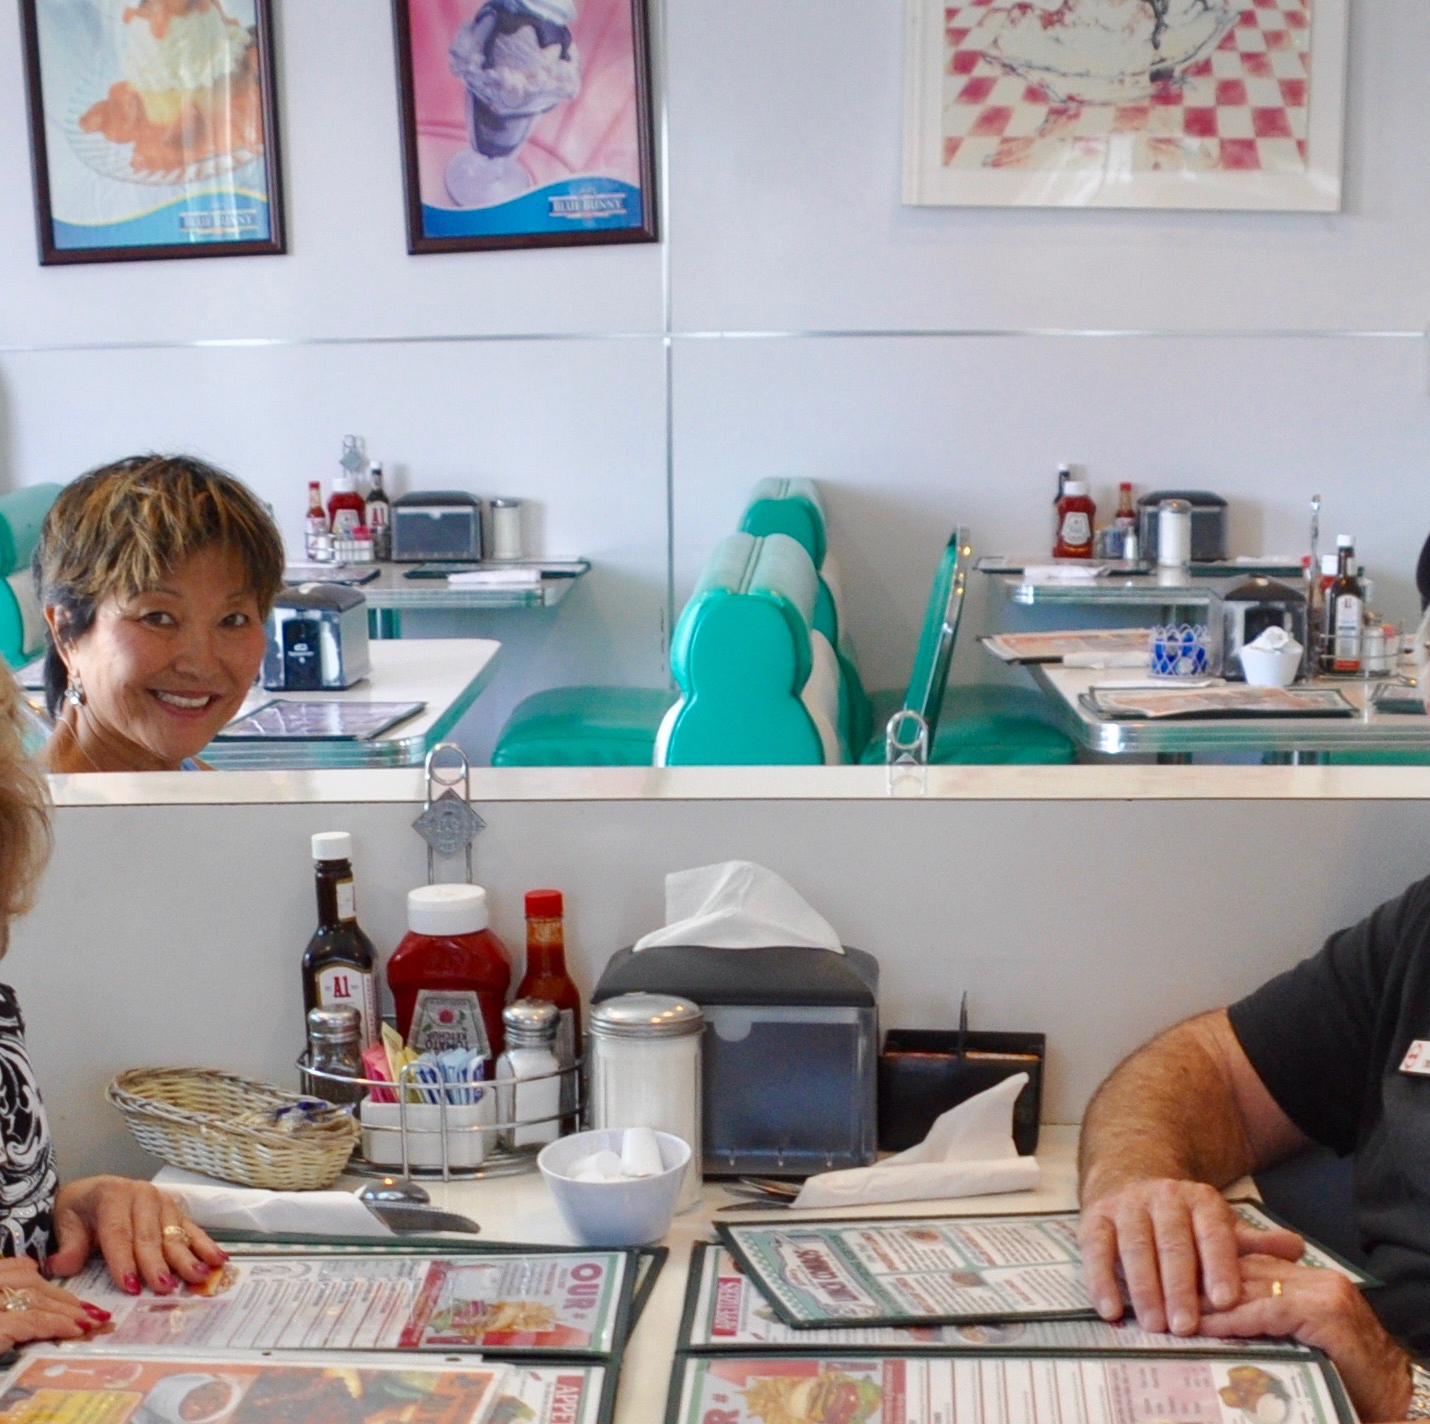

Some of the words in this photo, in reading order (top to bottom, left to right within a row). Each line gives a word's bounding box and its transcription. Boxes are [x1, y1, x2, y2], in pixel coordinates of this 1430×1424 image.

[582, 198, 622, 210] BUNNY
[563, 1263, 603, 1312] OUR
[717, 1280, 739, 1331] APPETIZERS
